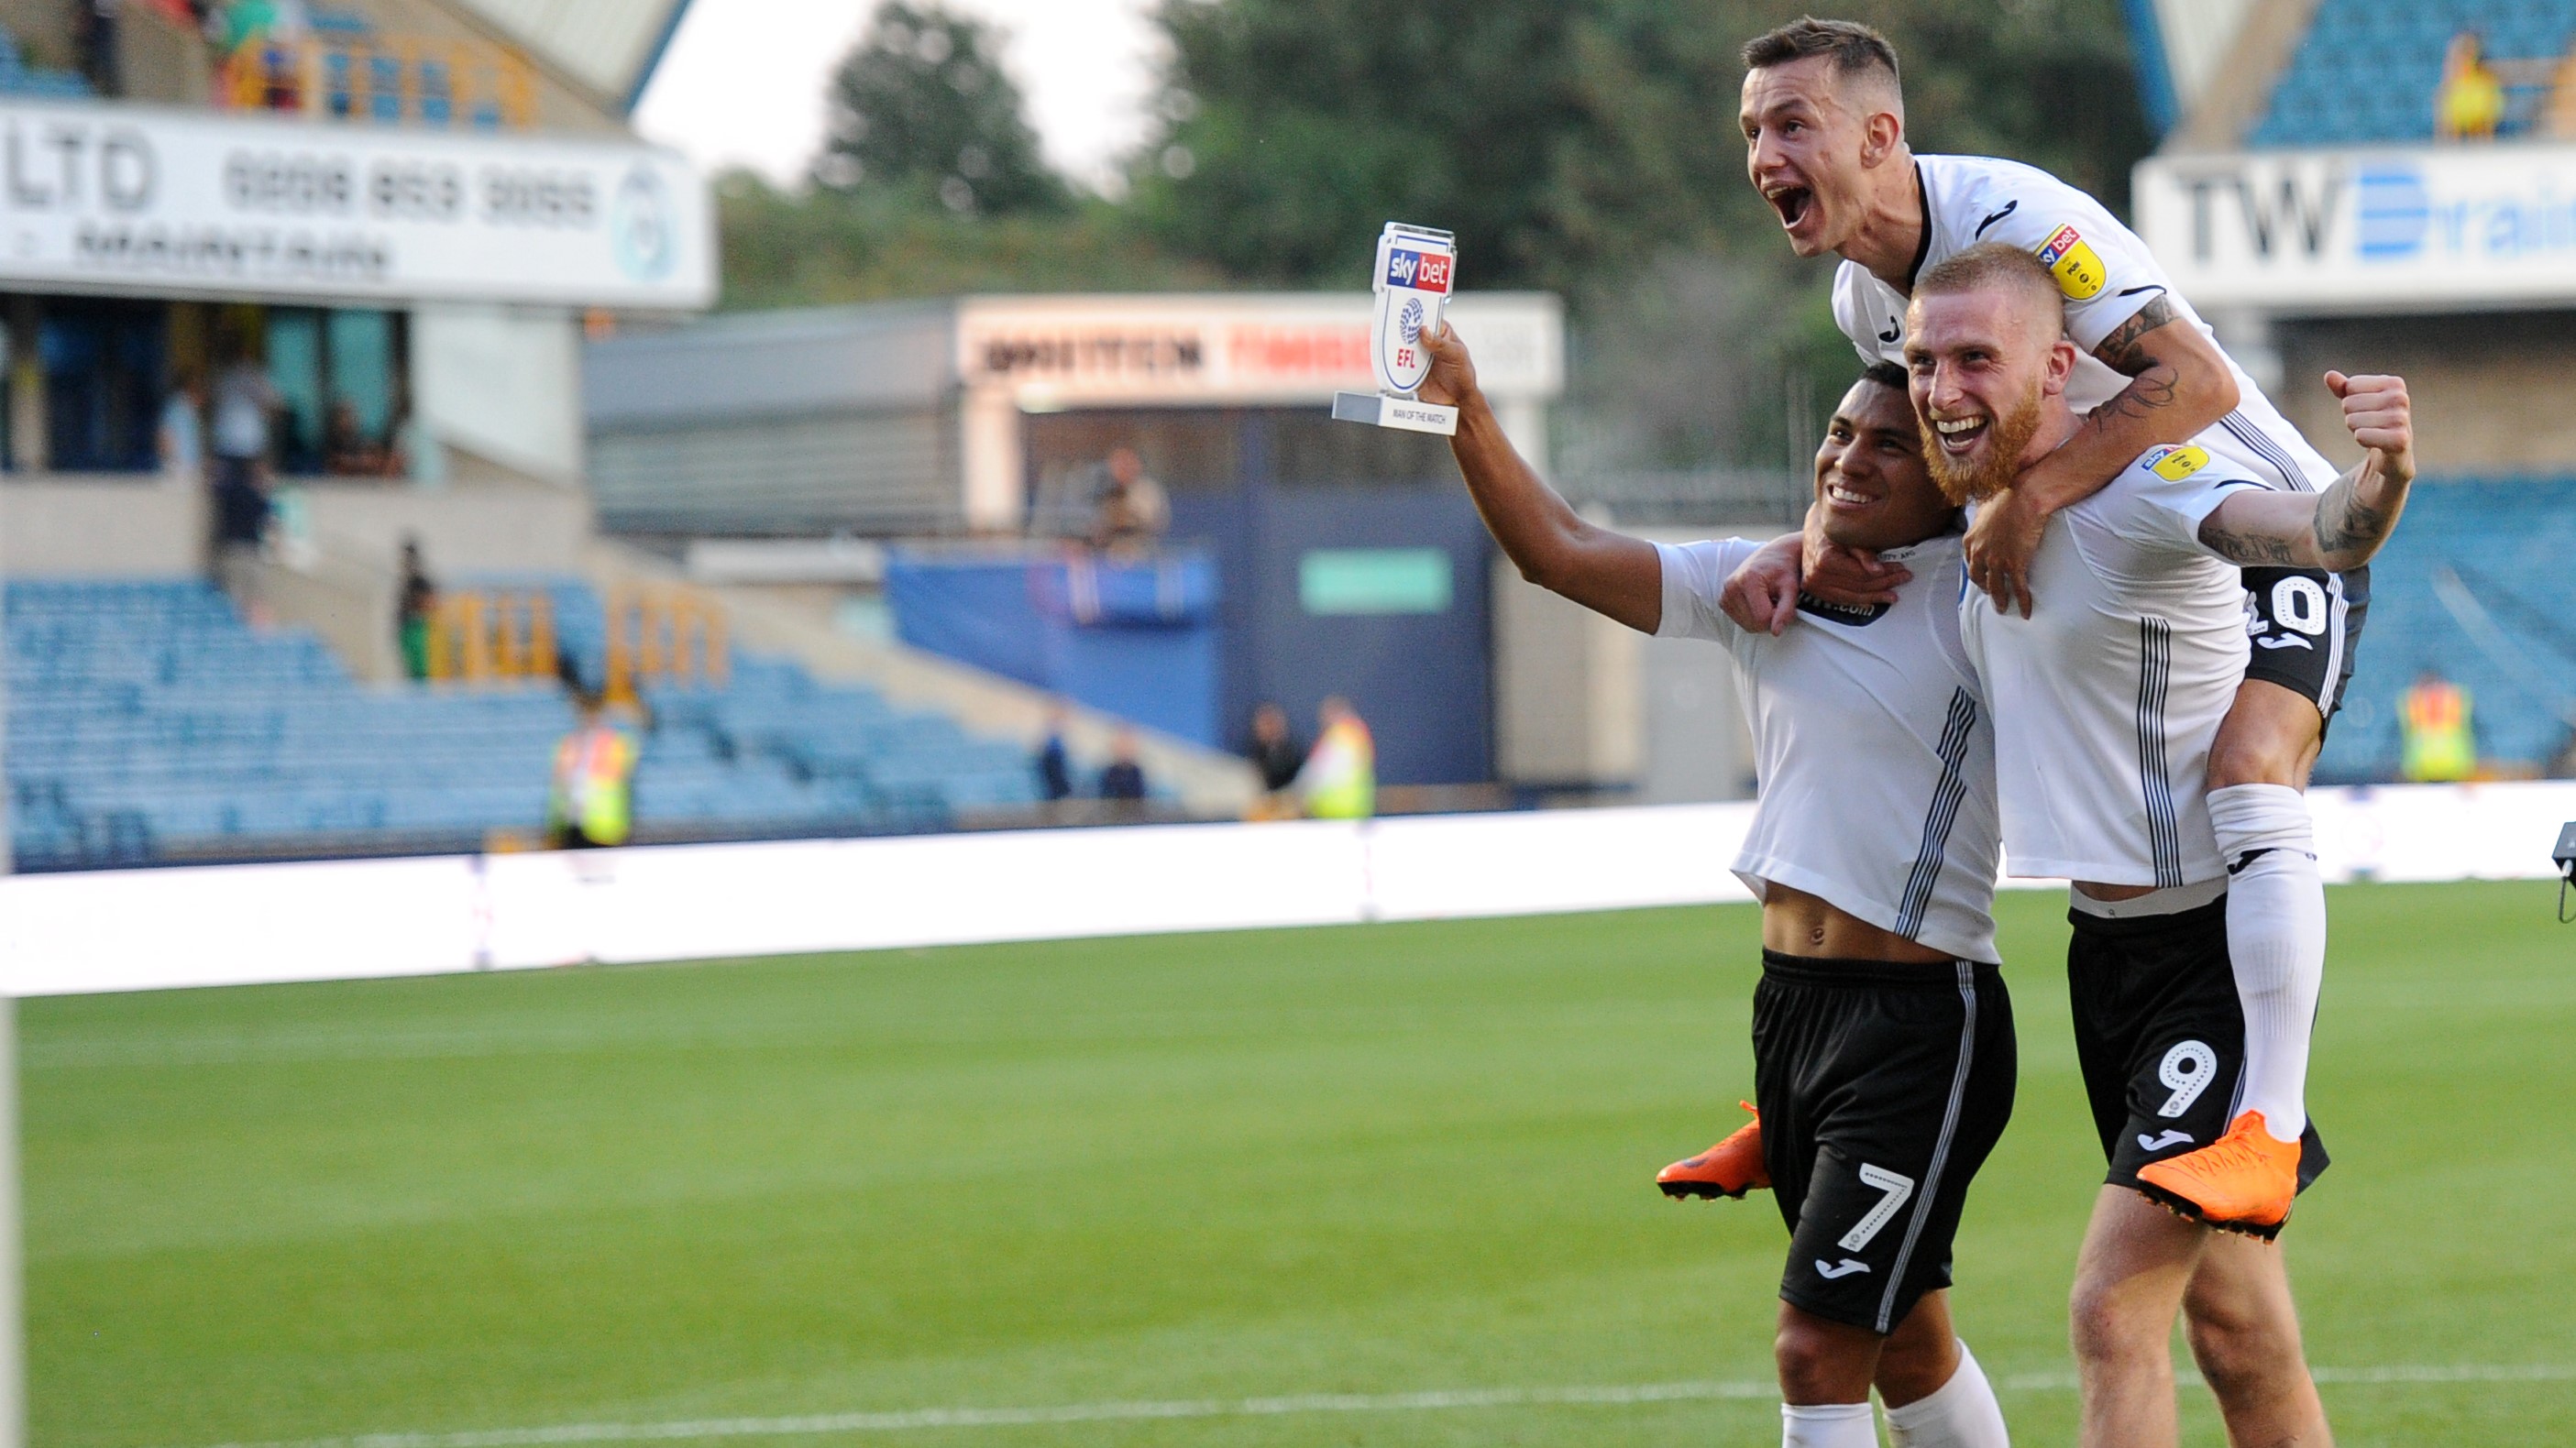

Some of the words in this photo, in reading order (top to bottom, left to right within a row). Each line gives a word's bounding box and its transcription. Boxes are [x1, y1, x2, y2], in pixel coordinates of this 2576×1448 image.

[3, 119, 158, 213] LTD
[2053, 228, 2077, 251] bet
[1391, 252, 1418, 285] sky
[1419, 257, 1447, 285] bet
[1397, 348, 1415, 368] EFL
[1393, 409, 1405, 419] MAN
[1406, 410, 1415, 420] OF
[1415, 411, 1426, 422] THE
[1427, 413, 1447, 425] MATCH
[2157, 1039, 2218, 1118] 9
[1837, 1162, 1915, 1253] 7
